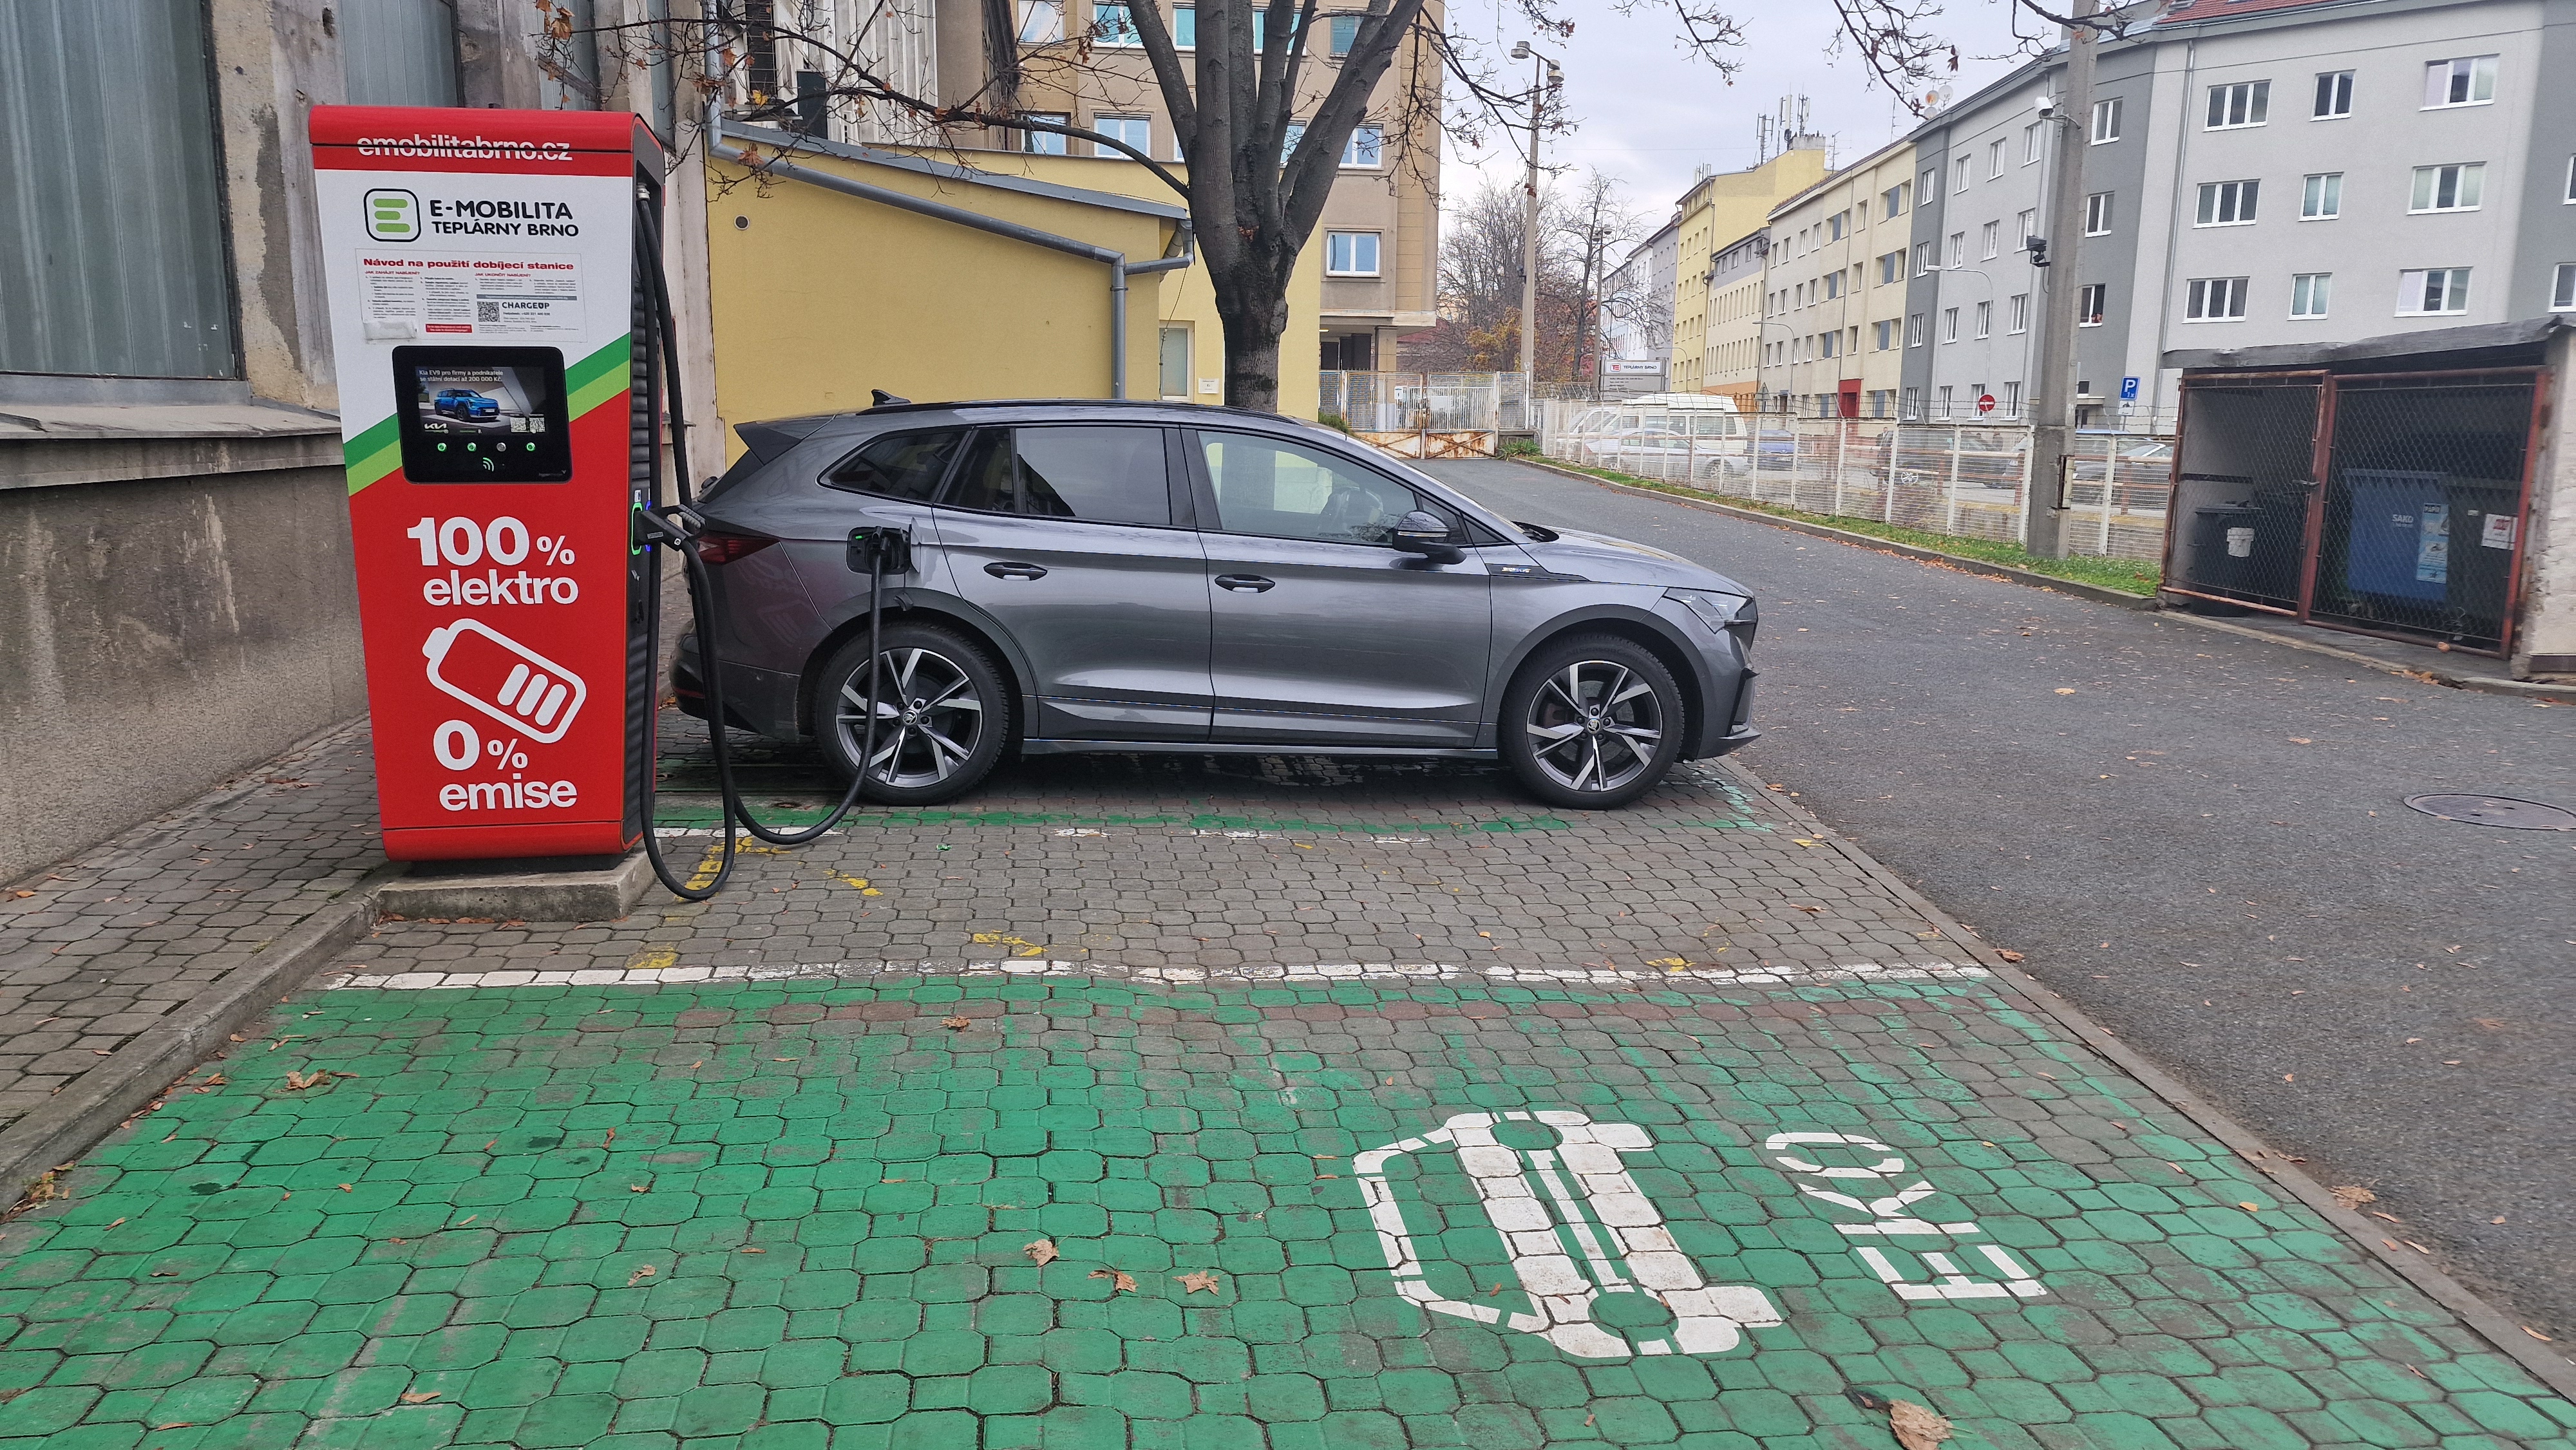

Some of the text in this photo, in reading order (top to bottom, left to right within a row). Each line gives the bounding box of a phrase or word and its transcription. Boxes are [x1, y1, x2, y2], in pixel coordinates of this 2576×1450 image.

[357, 133, 573, 161] emobilitabrno.cz
[430, 200, 573, 220] E-MOBILITA
[431, 219, 580, 237] TEPLÁRNY BRNO
[427, 260, 470, 268] použití
[473, 261, 524, 270] dobíjecí
[2125, 379, 2136, 393] P
[2392, 514, 2414, 523] SAKO
[407, 516, 576, 567] 100 %
[422, 569, 579, 607] elektro
[433, 719, 529, 771] 0 %
[439, 773, 578, 811] emise
[1765, 1132, 2047, 1300] EKO
